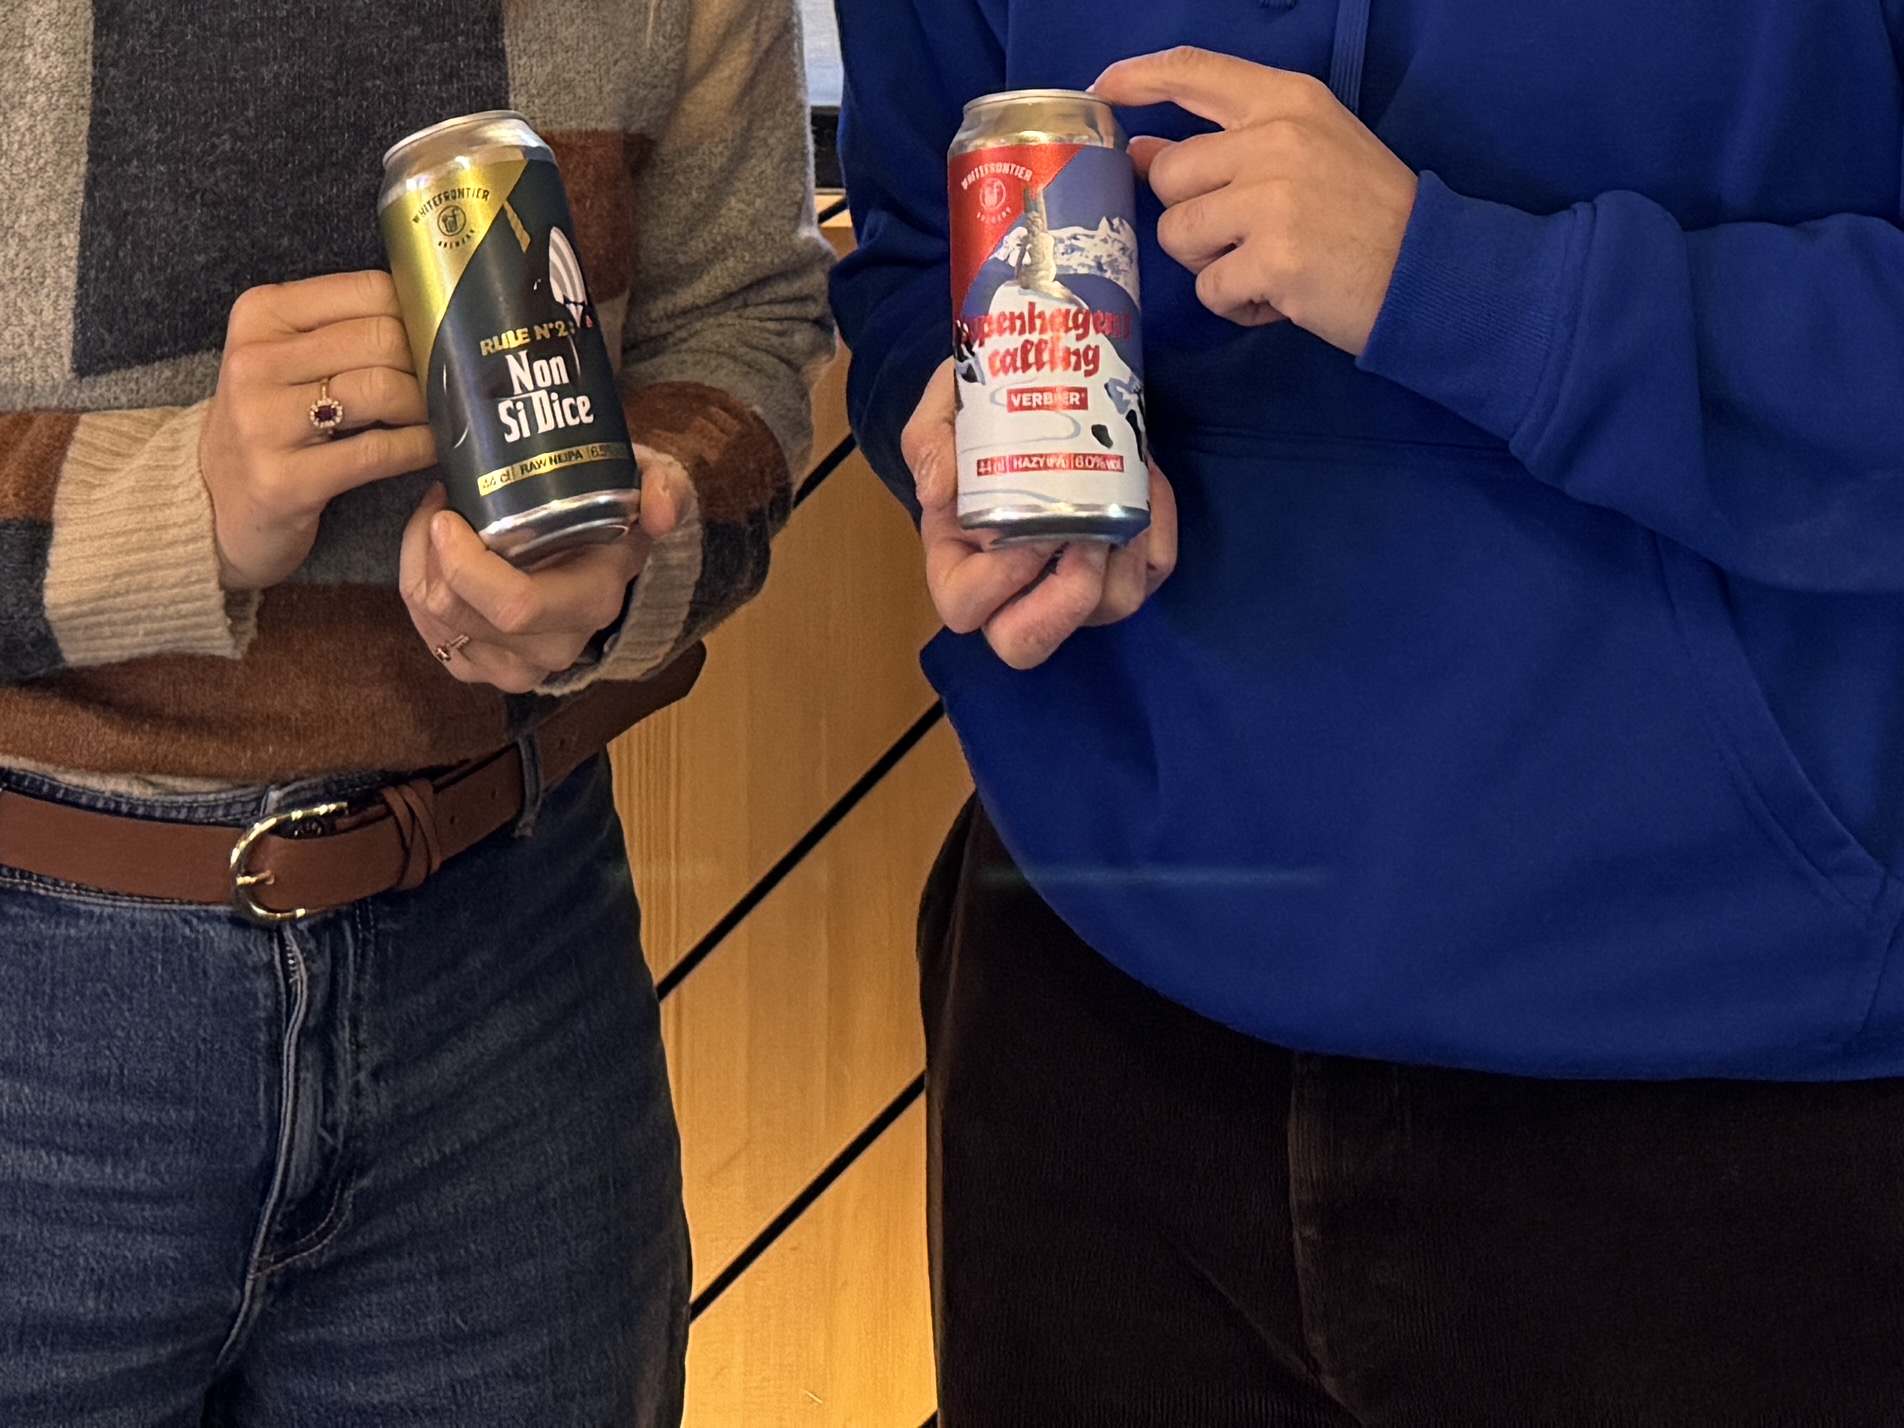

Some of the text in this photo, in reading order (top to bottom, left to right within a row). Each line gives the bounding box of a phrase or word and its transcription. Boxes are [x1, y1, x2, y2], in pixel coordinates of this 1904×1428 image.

[479, 327, 532, 357] RULE
[504, 349, 570, 396] Non
[988, 338, 1100, 378] calling
[1010, 391, 1081, 408] VERBIER
[497, 388, 595, 443] Si Dice
[519, 456, 547, 476] RAW
[1012, 456, 1045, 470] HAZY
